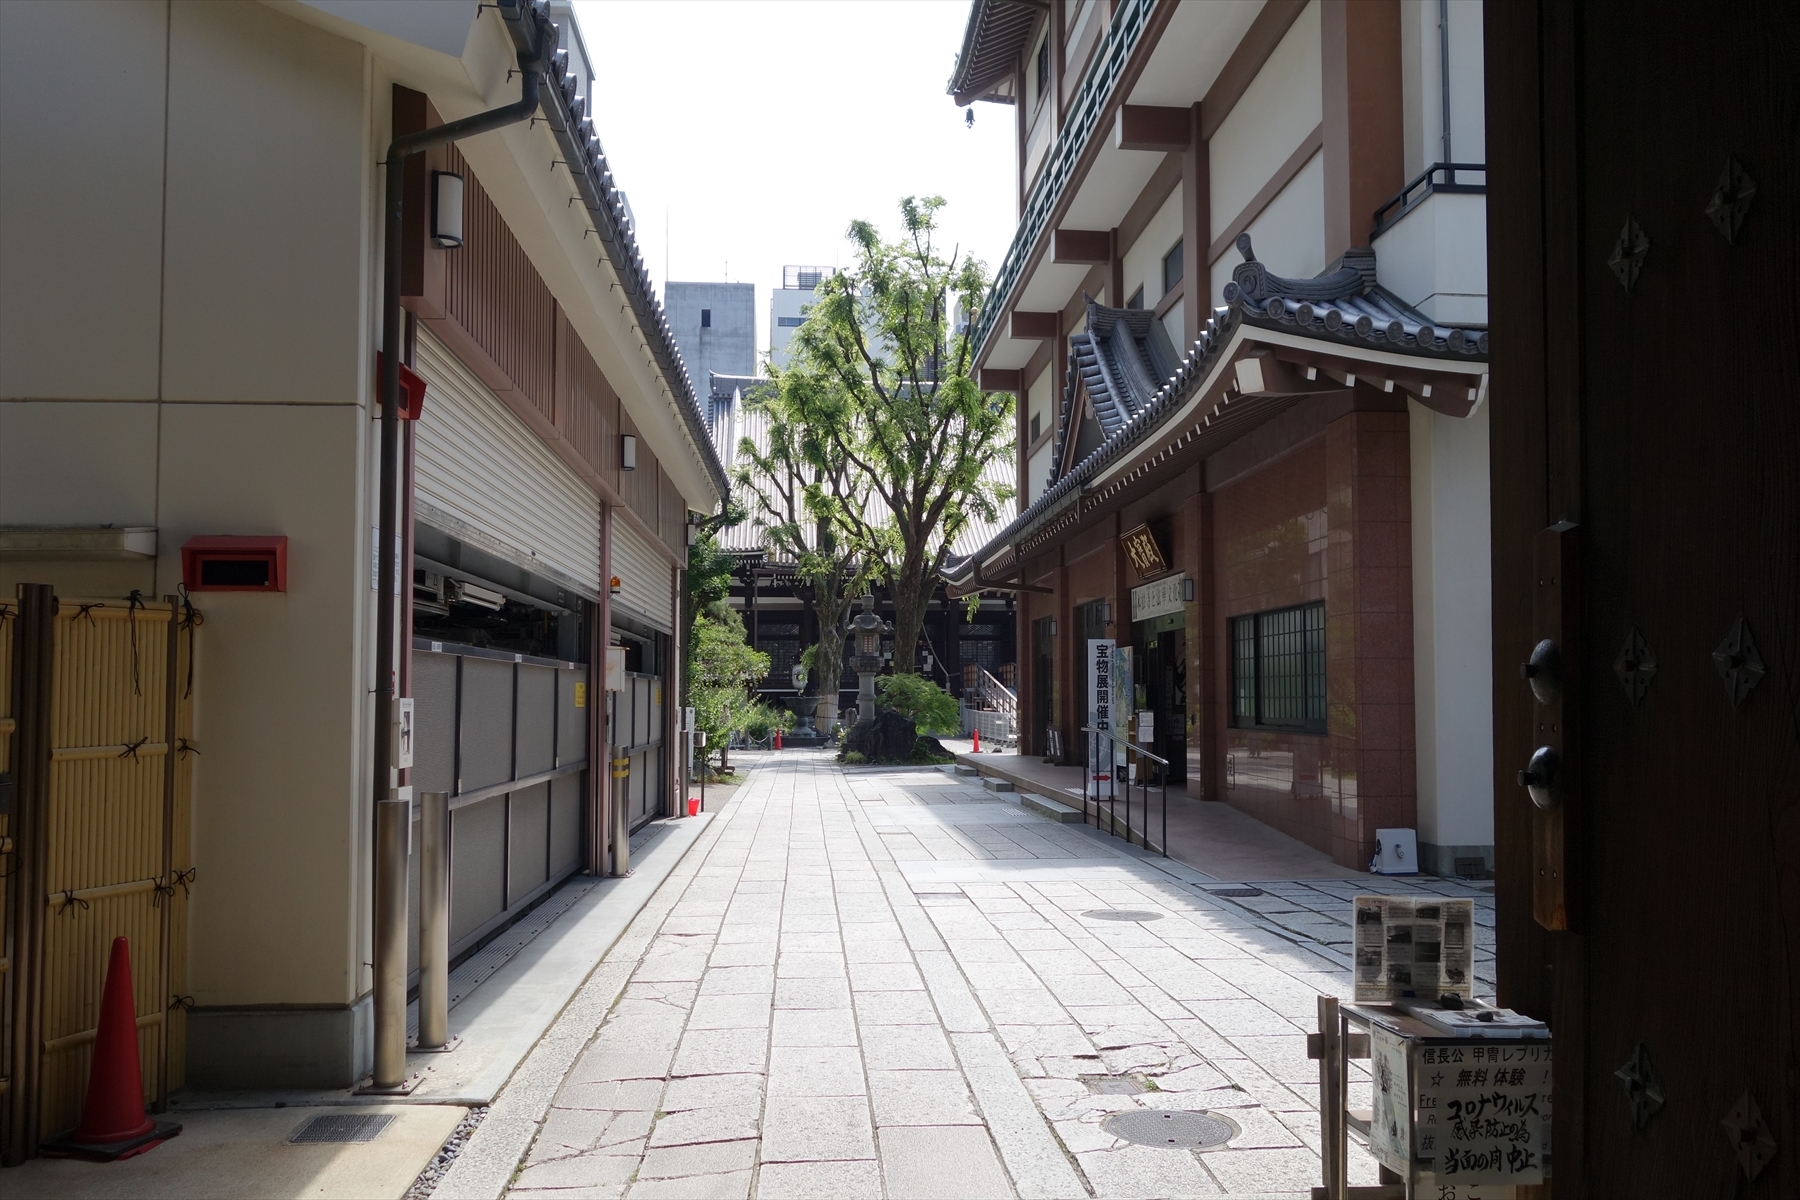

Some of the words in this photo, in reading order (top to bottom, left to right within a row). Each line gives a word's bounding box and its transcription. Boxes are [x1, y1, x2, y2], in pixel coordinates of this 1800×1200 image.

[1423, 1048, 1464, 1064] 信長公
[1456, 1068, 1489, 1087] 無料
[1494, 1067, 1526, 1086] 体験
[1450, 1117, 1530, 1143] 感染防止の為
